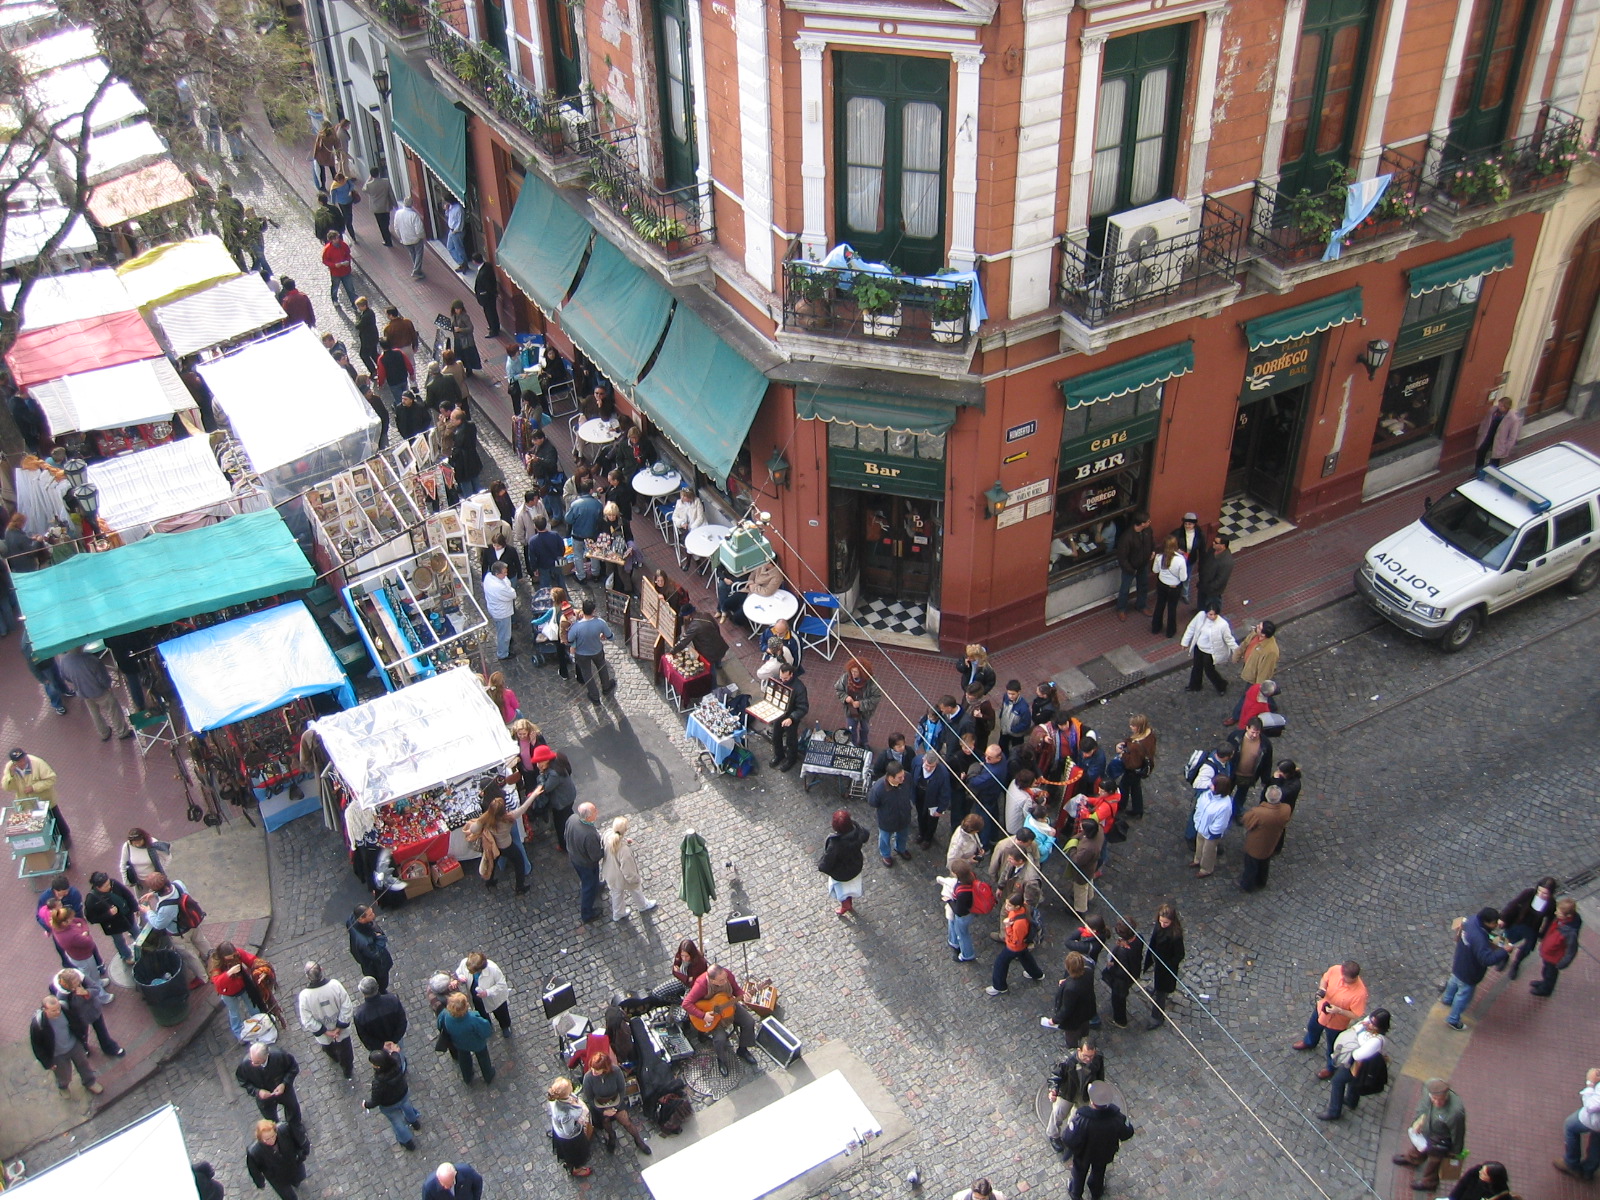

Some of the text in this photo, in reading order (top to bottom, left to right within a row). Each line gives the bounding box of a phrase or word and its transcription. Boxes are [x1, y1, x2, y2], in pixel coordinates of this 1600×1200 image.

[1422, 322, 1447, 337] Bar
[1282, 337, 1310, 351] PLAZA
[1253, 349, 1308, 377] DORREGO
[1289, 365, 1308, 376] BAR
[1009, 423, 1034, 440] HUMBERTO I
[1090, 430, 1128, 452] Café
[863, 462, 901, 478] Bar
[1075, 452, 1125, 480] BAR
[1086, 489, 1117, 505] DORREGO
